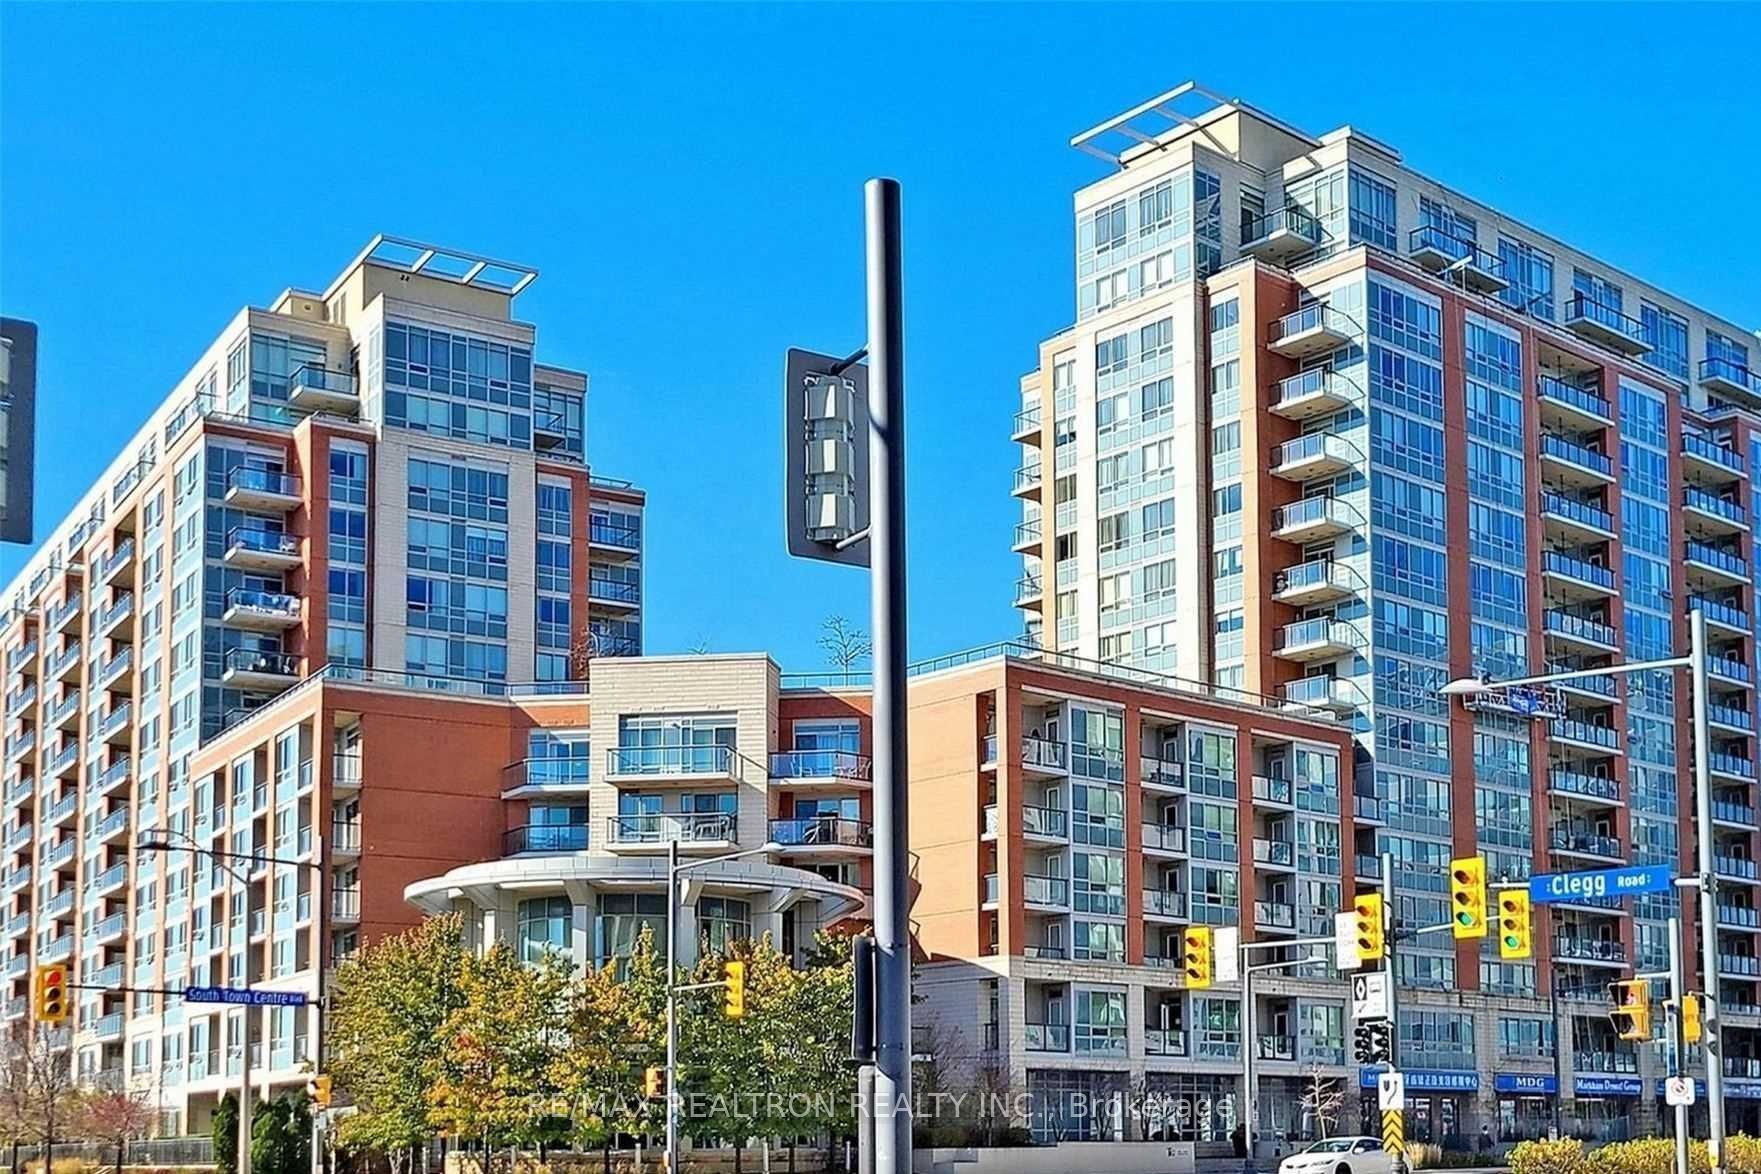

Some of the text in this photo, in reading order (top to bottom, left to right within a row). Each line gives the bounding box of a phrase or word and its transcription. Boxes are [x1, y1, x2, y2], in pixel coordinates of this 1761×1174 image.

[1552, 873, 1646, 897] Clegg Road
[188, 988, 220, 1001] South
[223, 990, 251, 1003] Town
[254, 991, 289, 1004] Centre
[1516, 1077, 1545, 1088] MDG
